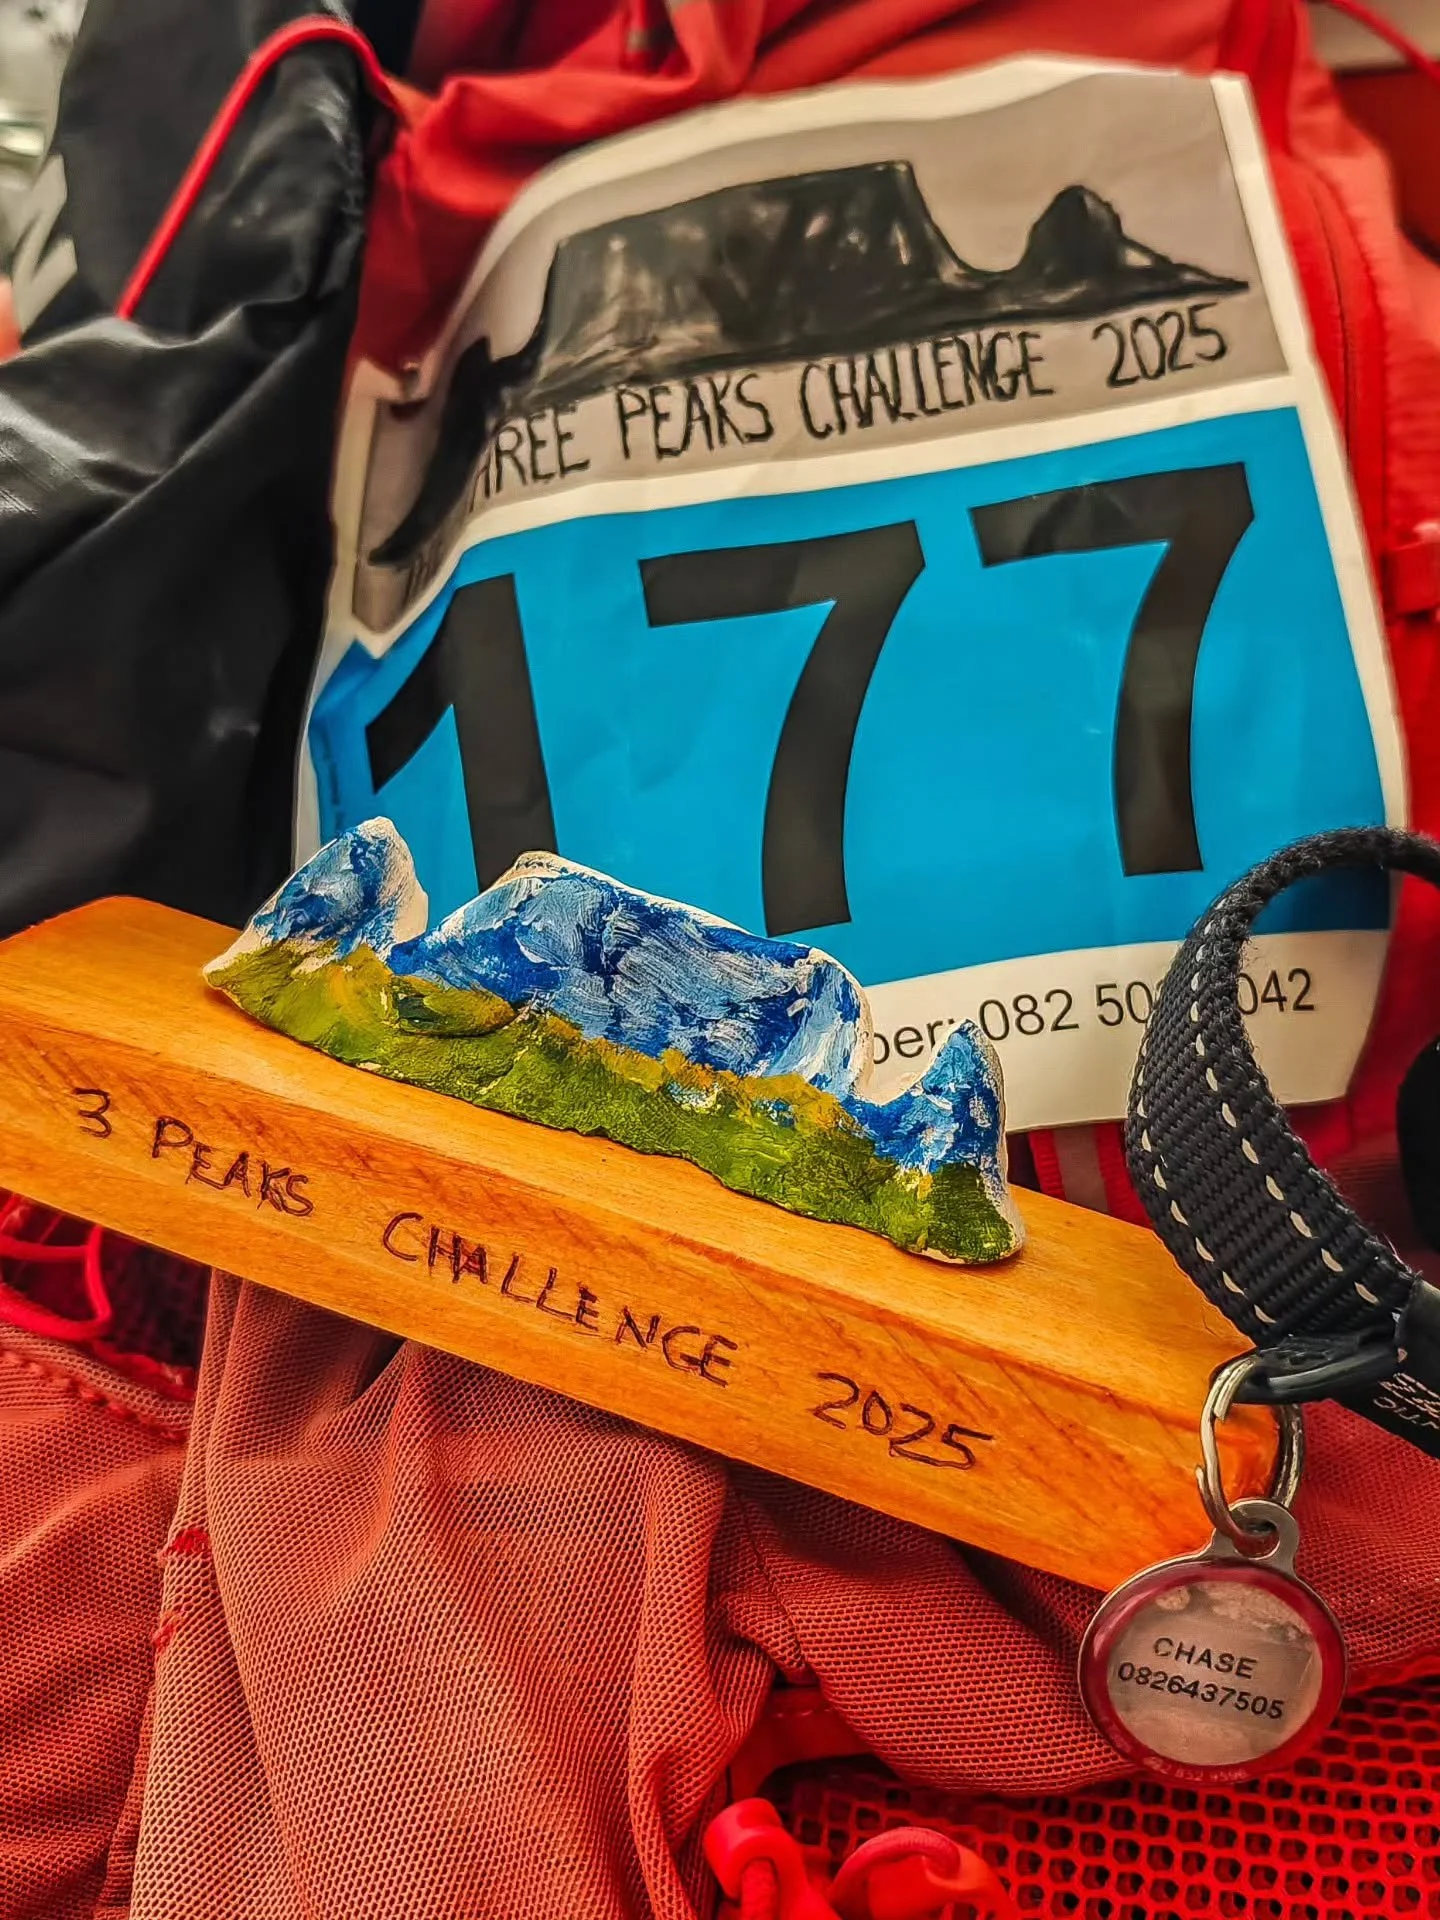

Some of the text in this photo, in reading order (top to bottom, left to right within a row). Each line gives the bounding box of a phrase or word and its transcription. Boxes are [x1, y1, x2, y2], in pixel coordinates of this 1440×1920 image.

[615, 372, 775, 462] PEAKS
[799, 330, 1054, 440] CHALLENGE
[1092, 302, 1228, 389] 2025
[366, 461, 1255, 938] 177
[978, 988, 1080, 1042] 082
[73, 1087, 995, 1470] 3 PEAKS CHALLENGE 2025
[1117, 1661, 1286, 1720] 0826437505
[1152, 1636, 1258, 1680] CHASE
